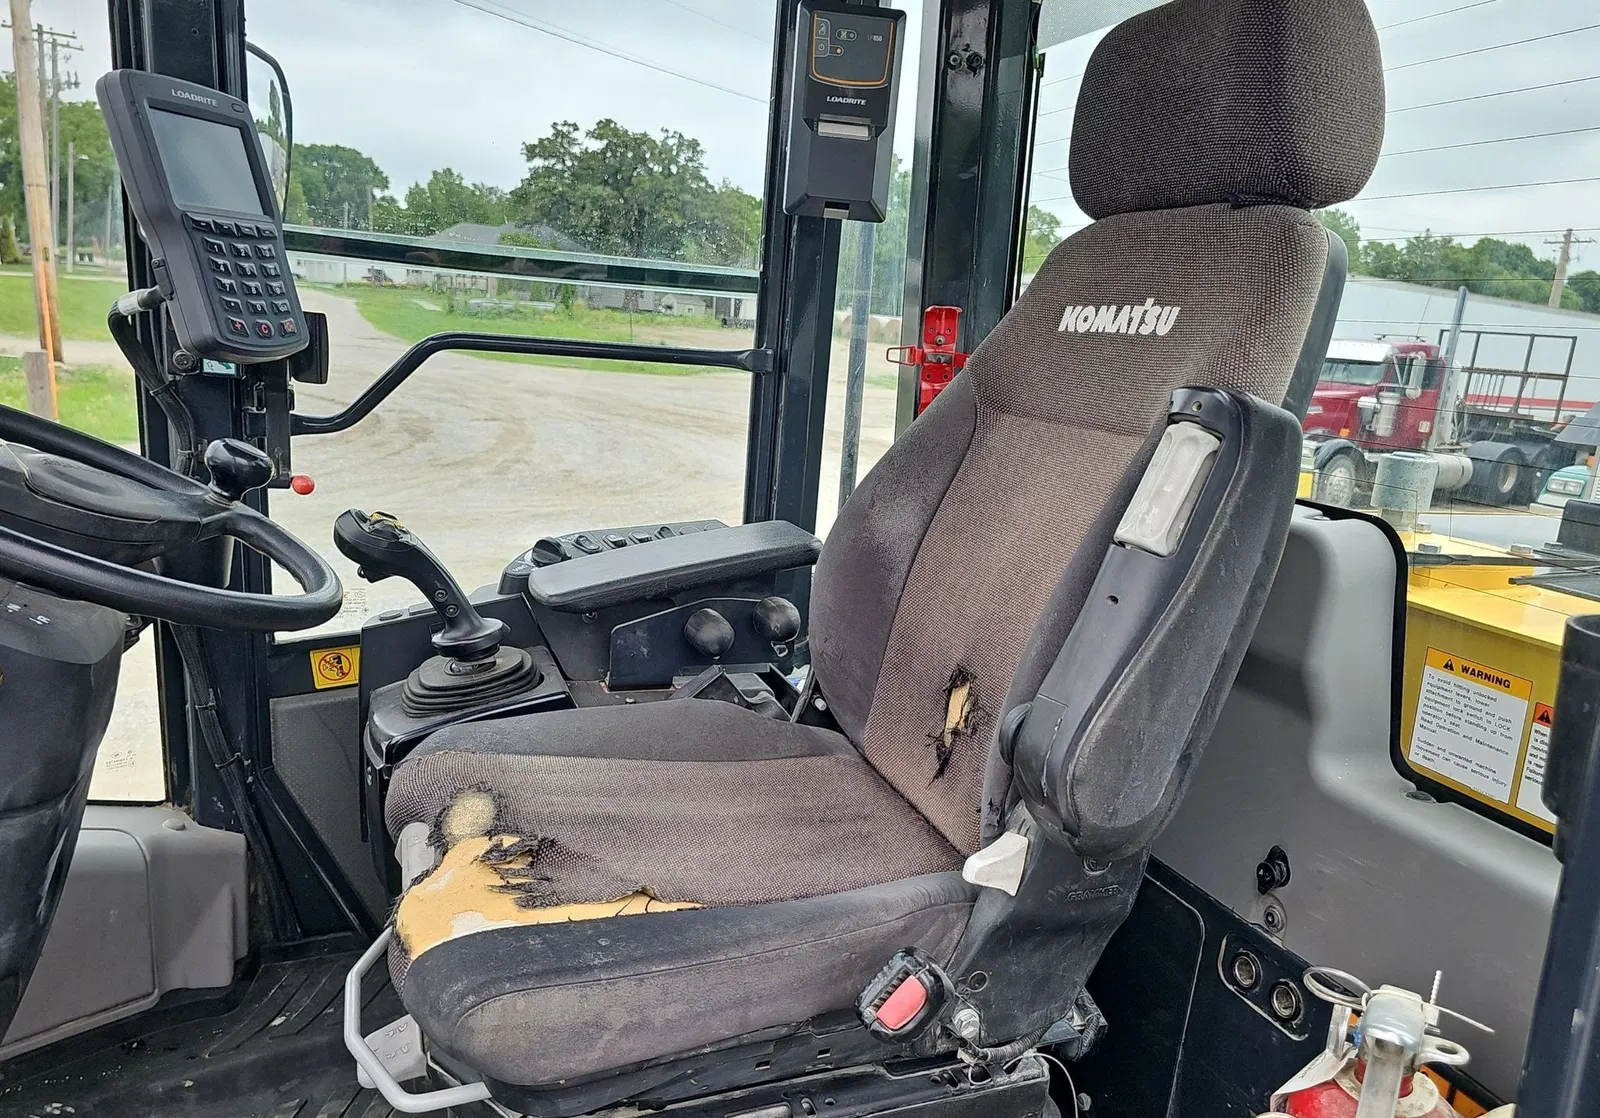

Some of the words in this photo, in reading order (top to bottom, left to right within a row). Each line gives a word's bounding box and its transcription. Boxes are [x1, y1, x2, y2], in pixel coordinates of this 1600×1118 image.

[172, 88, 218, 107] LOADRITE
[826, 96, 867, 106] LOADRITE
[220, 264, 225, 272] 4
[225, 284, 230, 292] 7
[262, 325, 268, 333] C
[1058, 298, 1181, 336] KOMATSU
[1461, 664, 1511, 688] WARNING
[1426, 681, 1453, 694] equipment
[1475, 698, 1490, 707] lower
[1437, 677, 1451, 686] avoid
[1472, 690, 1497, 702] unlocked
[1421, 710, 1446, 723] operator's
[1424, 695, 1450, 708] equipment
[1452, 705, 1463, 714] lock
[1466, 711, 1483, 721] switch
[1425, 688, 1453, 702] attachment
[1463, 702, 1482, 713] ground
[1497, 715, 1512, 724] push
[1422, 702, 1443, 713] position
[1445, 710, 1462, 721] before
[1464, 718, 1487, 732] standing
[1499, 731, 1513, 741] from
[1420, 716, 1433, 725] Read
[1435, 722, 1460, 736] Operation
[1474, 738, 1509, 755] Maintenance
[1415, 744, 1440, 758] movement
[1452, 761, 1468, 770] cause
[1470, 768, 1489, 779] serious
[1491, 776, 1507, 788] injury
[1417, 736, 1434, 748] Sudden
[1448, 751, 1473, 764] unwanted
[1474, 762, 1496, 774] machine
